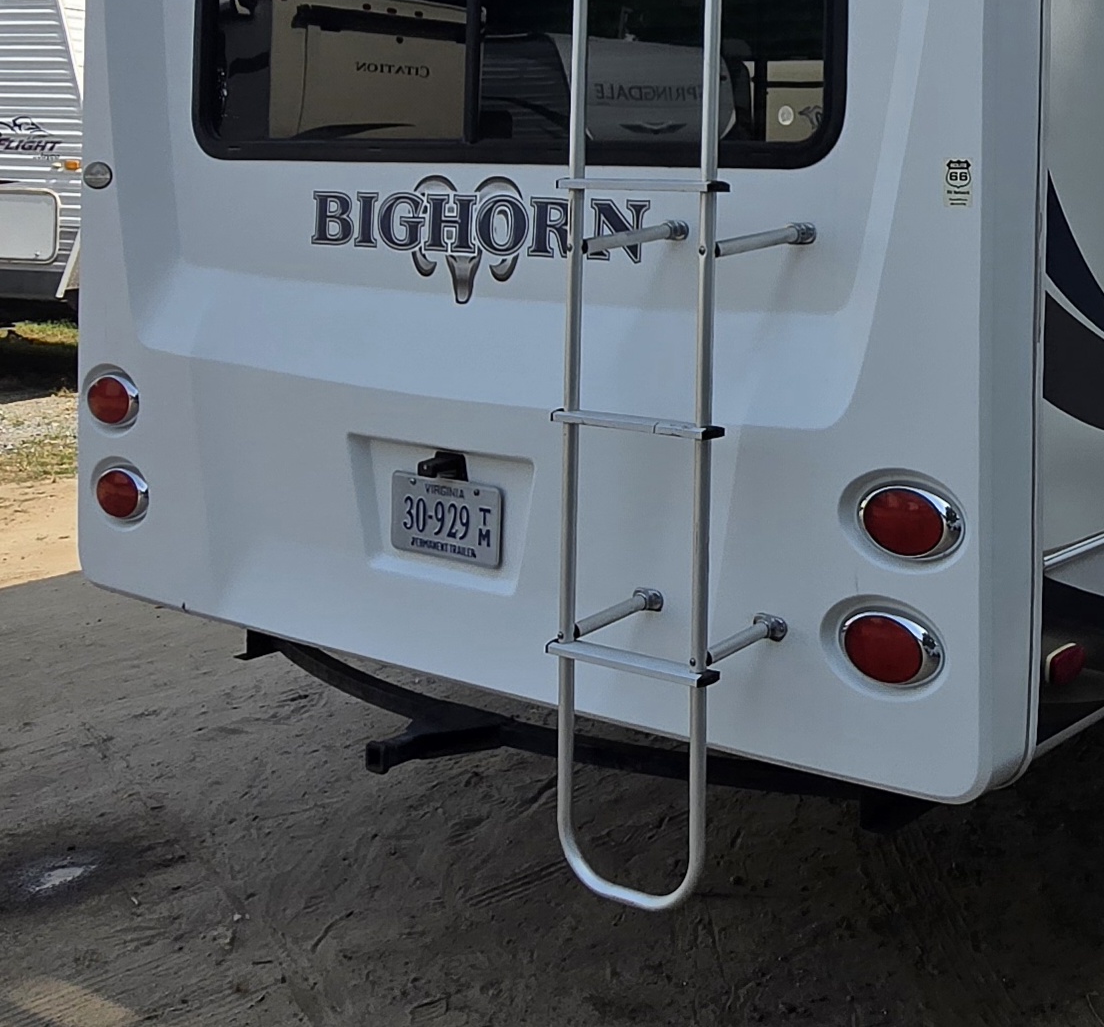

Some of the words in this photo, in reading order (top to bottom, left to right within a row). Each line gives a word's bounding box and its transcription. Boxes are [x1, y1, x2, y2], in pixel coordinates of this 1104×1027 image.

[949, 171, 968, 181] 66
[310, 189, 651, 264] BIGHORN
[425, 484, 465, 499] VIRGINIA
[403, 495, 470, 541] 30-929
[449, 544, 477, 558] TRAILER
